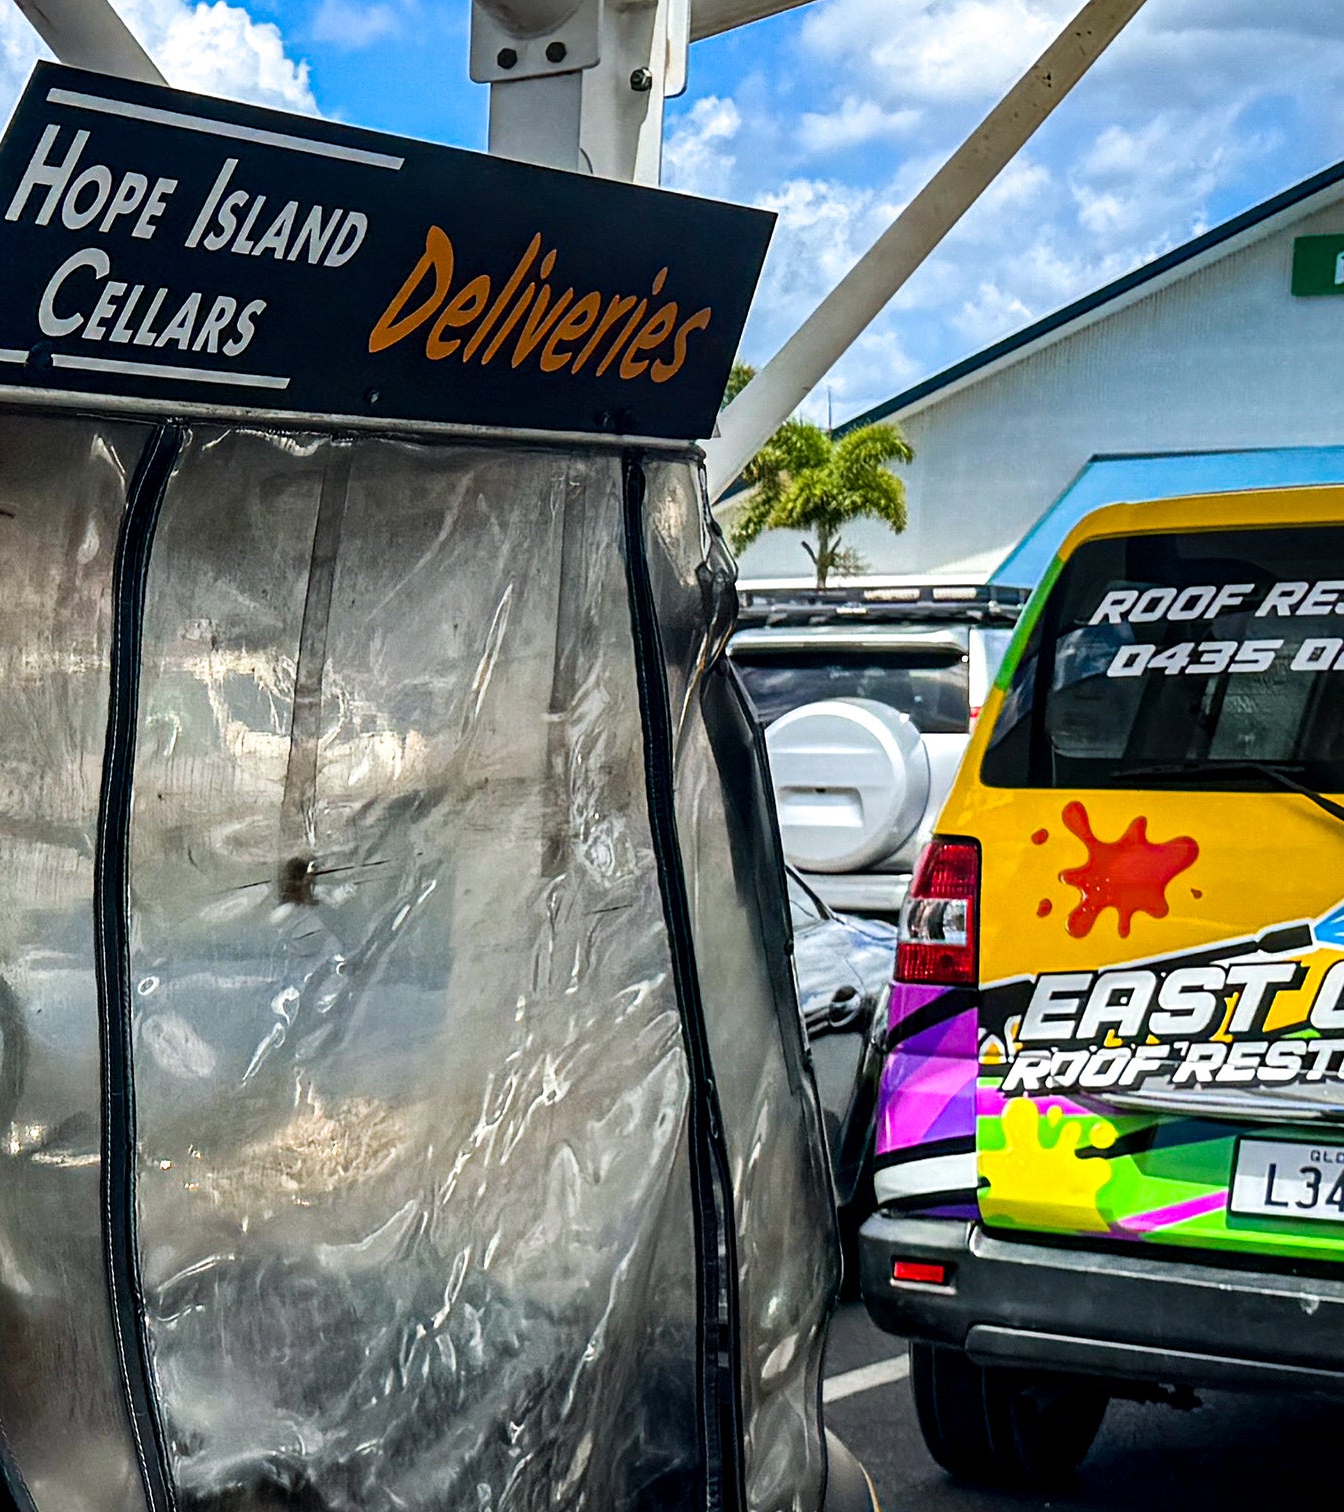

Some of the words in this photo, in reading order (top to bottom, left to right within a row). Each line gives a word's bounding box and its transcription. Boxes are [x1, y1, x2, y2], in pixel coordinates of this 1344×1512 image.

[5, 123, 179, 241] HOPE
[185, 157, 369, 268] ISLAND
[38, 248, 266, 357] CELLARS
[369, 225, 711, 383] Deliveries
[1088, 584, 1255, 626] ROOF
[1254, 580, 1344, 617] RE
[1107, 639, 1284, 678] 0435
[1290, 638, 1344, 672] 0
[1018, 963, 1297, 1041] EAST
[1002, 1044, 1170, 1091] ROOF
[1173, 1040, 1344, 1083] REST
